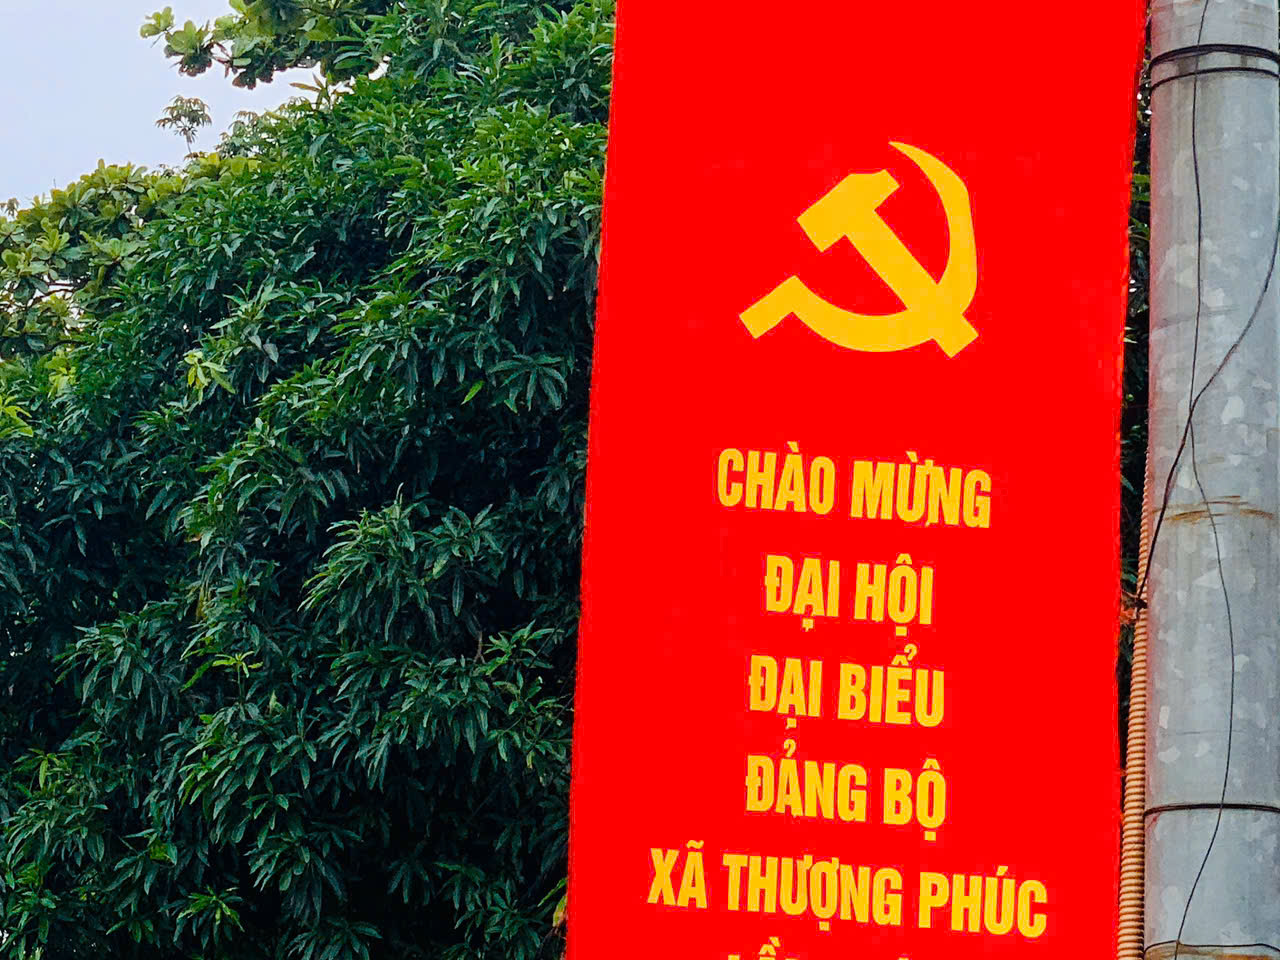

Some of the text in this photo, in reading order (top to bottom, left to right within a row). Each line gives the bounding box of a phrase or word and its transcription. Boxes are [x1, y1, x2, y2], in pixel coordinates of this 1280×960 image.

[718, 441, 992, 528] CHÀO MỪNG
[765, 553, 933, 636] ĐẠI HỘI
[748, 644, 945, 729] ĐẠI BIỂU
[746, 739, 946, 840] ĐẢNG BỘ
[647, 840, 1047, 937] XÃ THƯỢNG PHÚC
